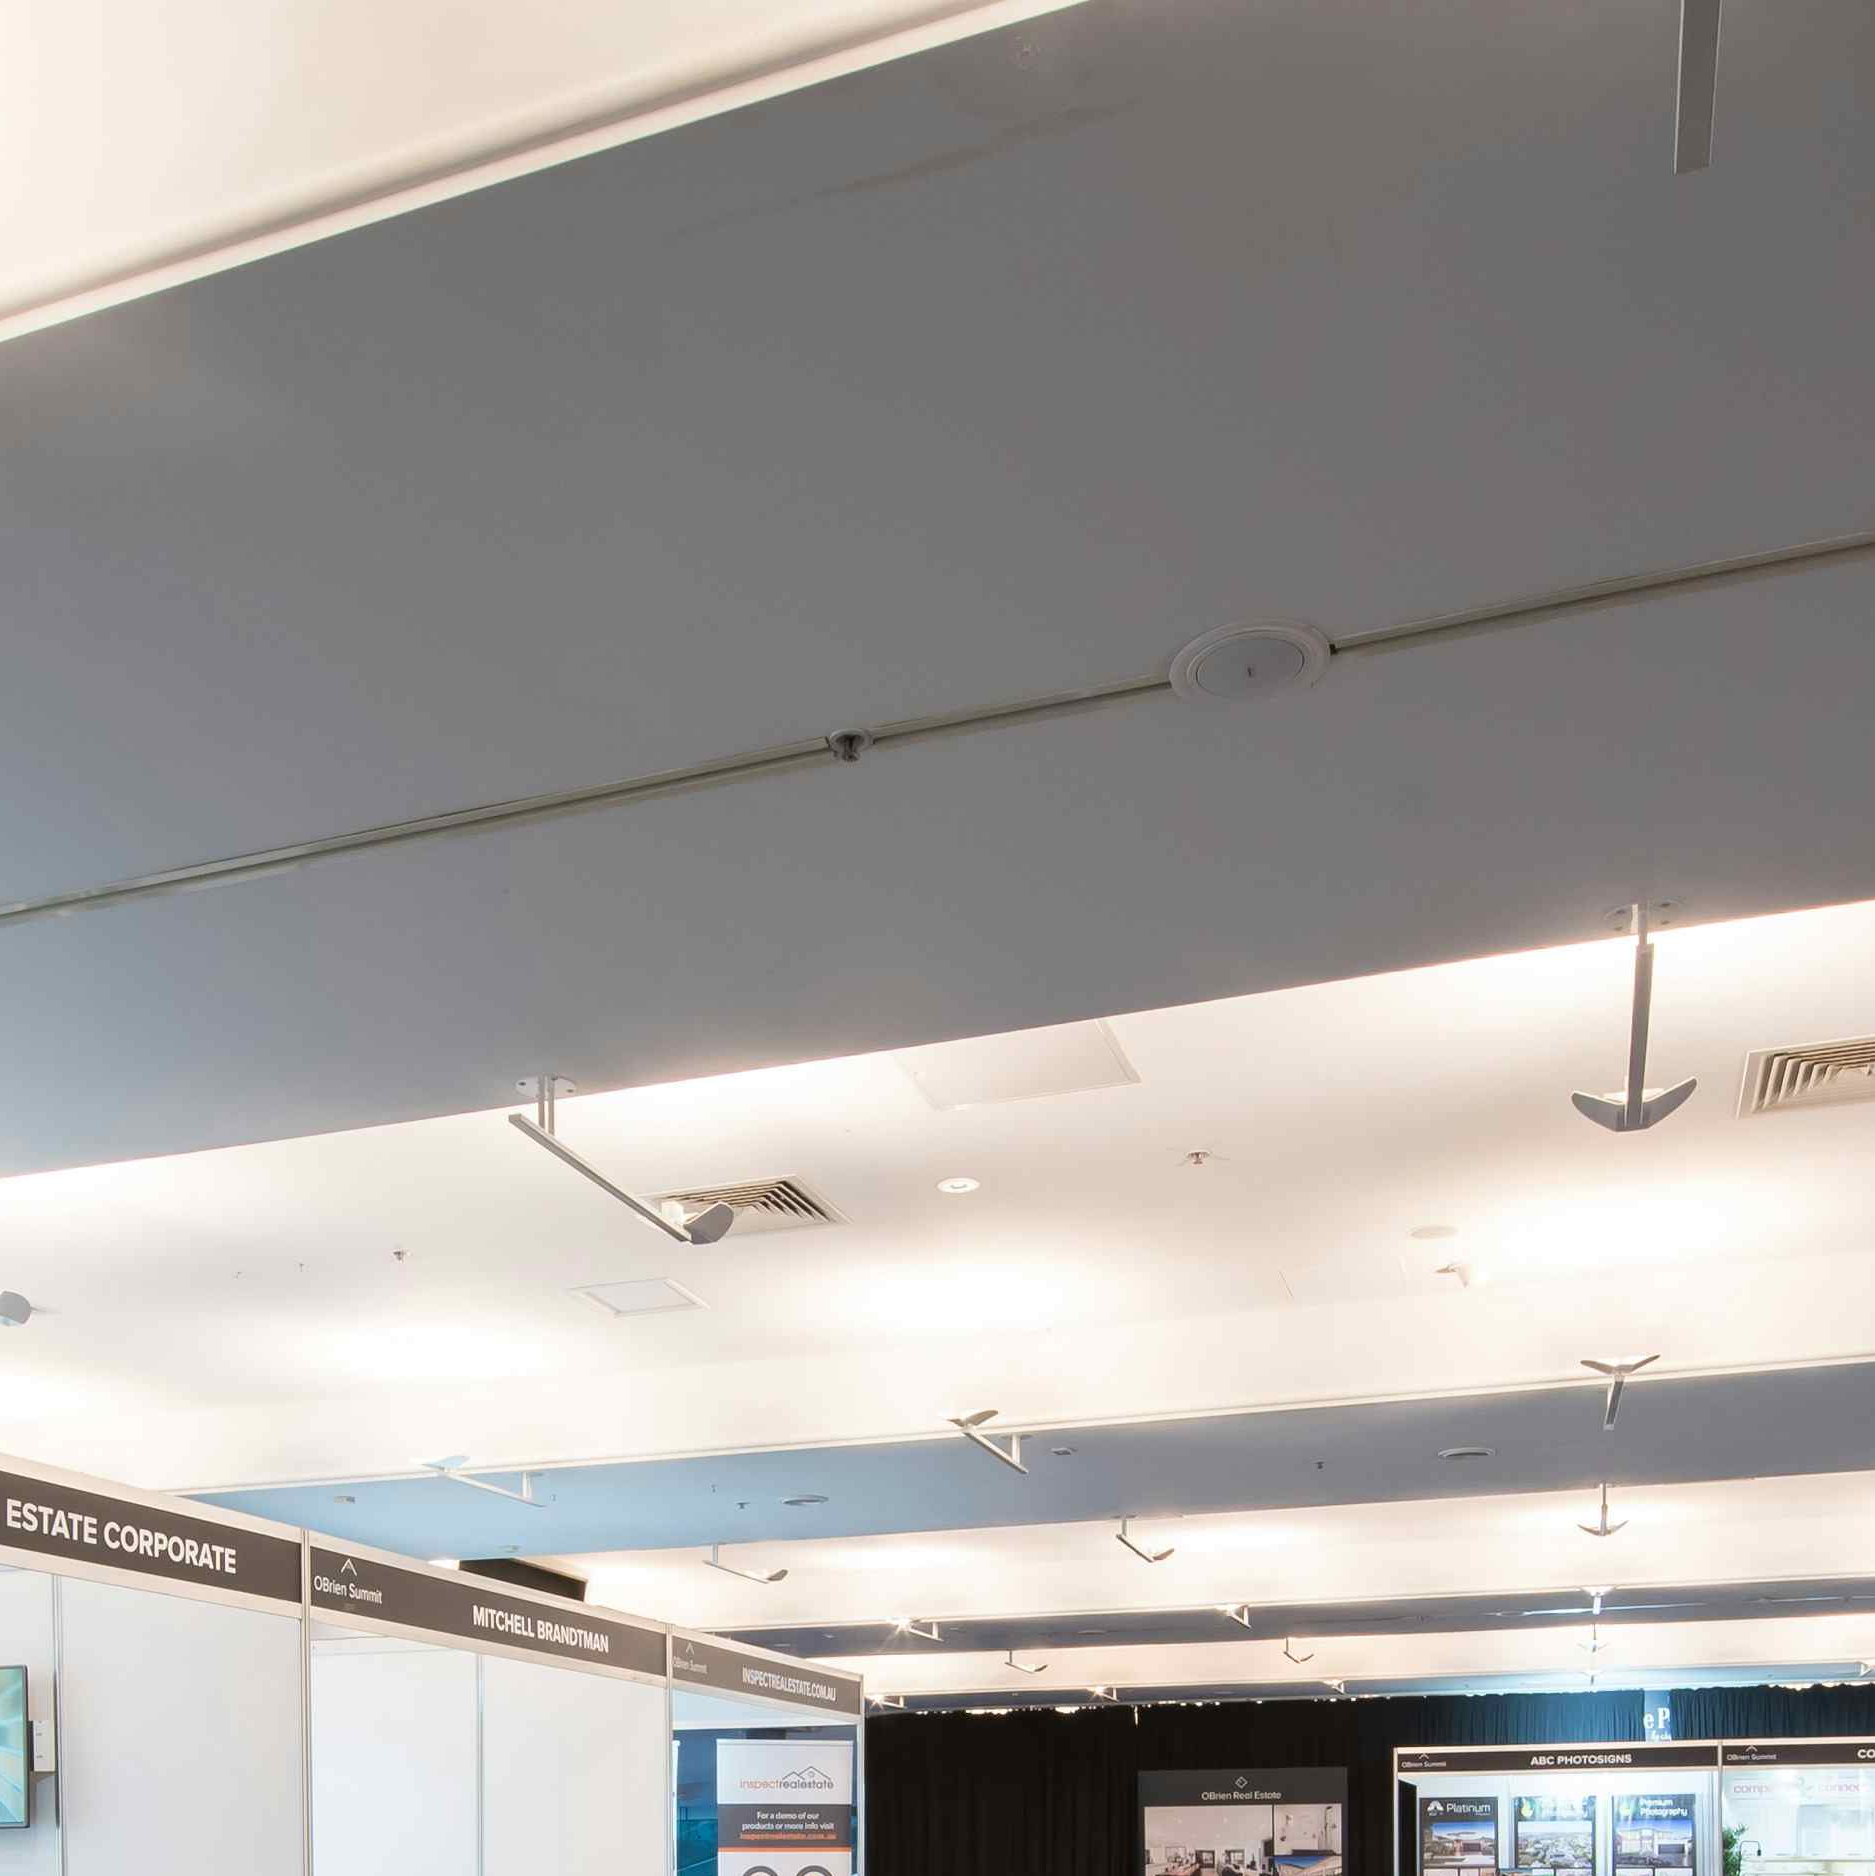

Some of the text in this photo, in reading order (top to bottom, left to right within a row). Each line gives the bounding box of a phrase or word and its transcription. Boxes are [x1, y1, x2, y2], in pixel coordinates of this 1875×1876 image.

[6, 1500, 98, 1545] ESTATE
[103, 1522, 237, 1575] CORPORATE
[313, 1575, 382, 1605] OBrien Summit
[472, 1605, 609, 1653] MITCHELL BRANDTMAN
[742, 1664, 837, 1702] INSPECTREALESTATE.COM.AU
[1530, 1753, 1632, 1766] ABC PHOTOSIGNS
[740, 1779, 834, 1790] inspectrealestate
[1201, 1791, 1282, 1800] OBrien Real Estate
[1446, 1803, 1491, 1813] Platinum
[1639, 1807, 1688, 1818] Photography
[757, 1811, 768, 1819] For
[775, 1812, 797, 1820] demo
[742, 1823, 775, 1831] products
